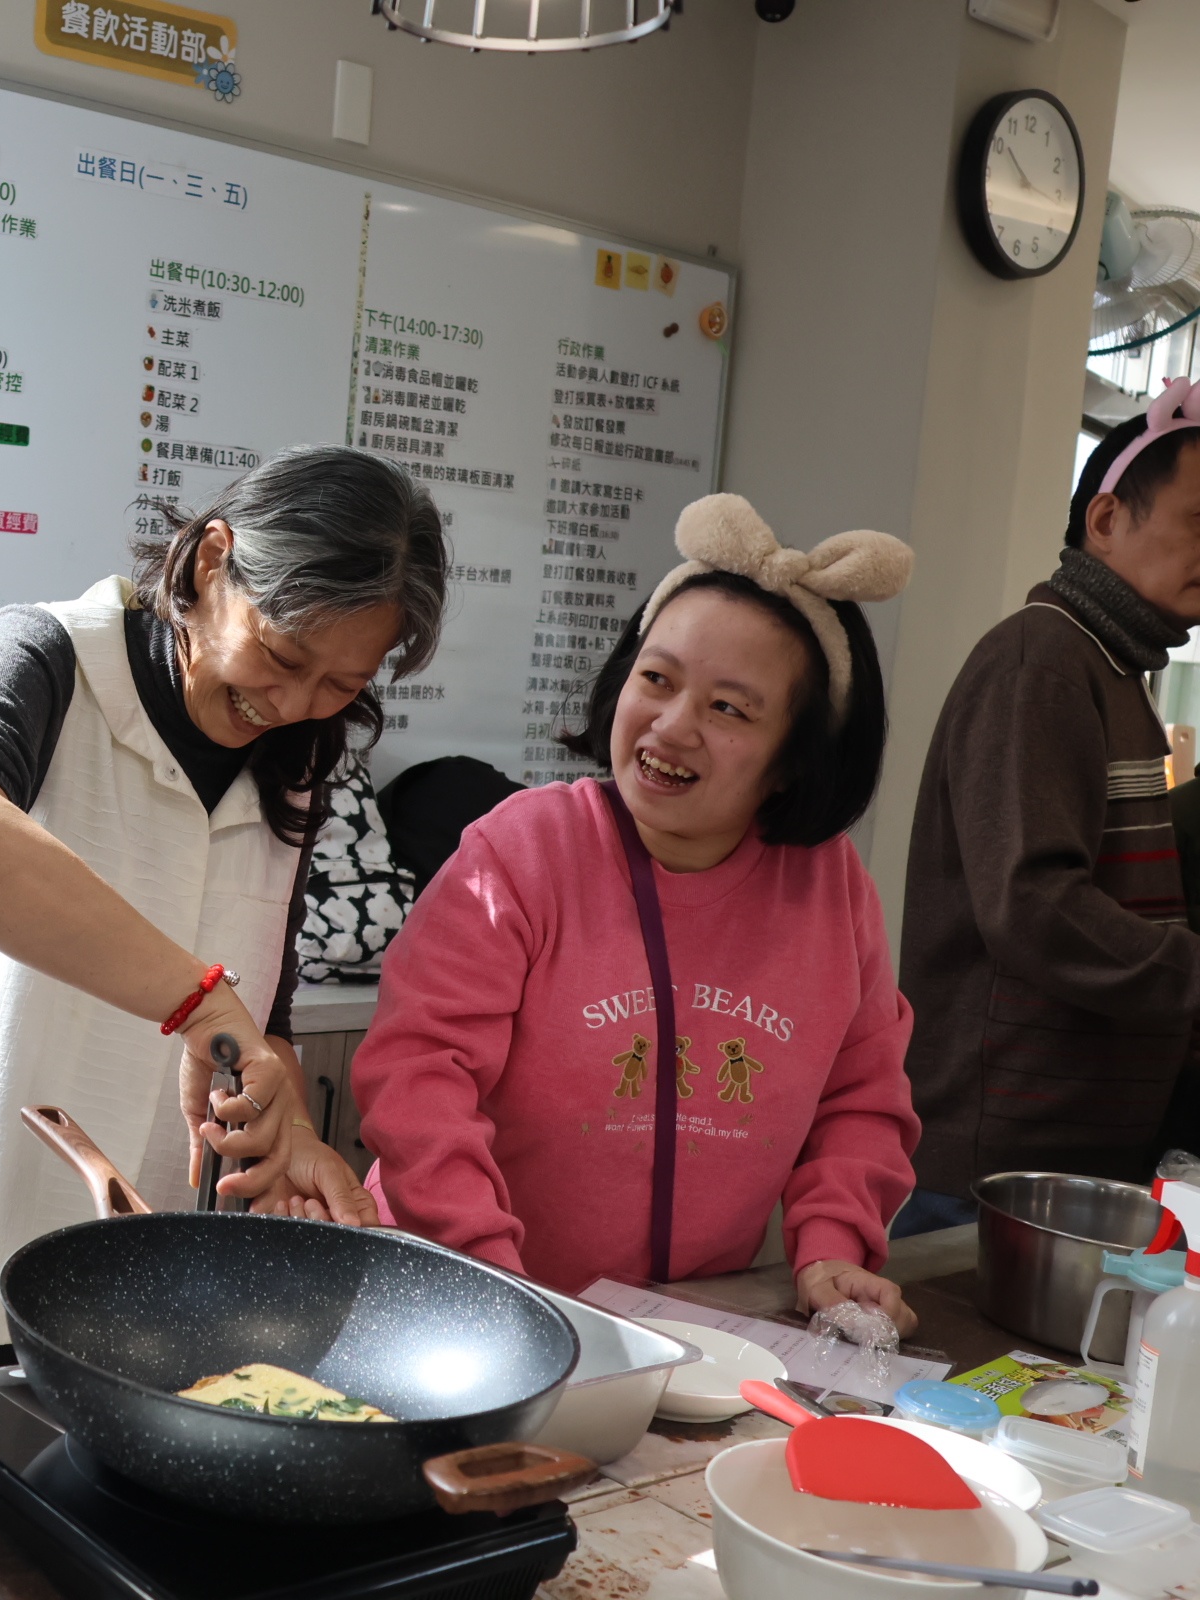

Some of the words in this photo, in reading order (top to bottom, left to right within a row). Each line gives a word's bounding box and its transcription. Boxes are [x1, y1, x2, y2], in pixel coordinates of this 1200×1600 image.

[61, 1, 207, 64] 餐飲活動部
[1008, 118, 1018, 136] 11
[1025, 114, 1037, 133] 12
[992, 135, 1004, 155] 10
[1045, 131, 1050, 147] 1
[1053, 157, 1061, 174] 2
[77, 153, 248, 209] 出餐日(一、三、五)
[997, 225, 1004, 240] 7
[1013, 239, 1021, 256] 6
[1031, 236, 1039, 253] 5
[150, 259, 305, 308] 出餐中(10:30-12:00)
[163, 294, 221, 318] 洗米煮飯
[161, 329, 190, 348] 主菜
[364, 309, 484, 349] 下午(14:00-17:30)
[365, 335, 420, 361] 清潔作業
[558, 338, 605, 361] 行政作業
[158, 359, 187, 379] 配菜
[191, 366, 198, 381] 1
[643, 376, 659, 389] ICF
[157, 390, 186, 411] 配菜
[189, 398, 199, 413] 2
[155, 415, 169, 432] 湯
[157, 441, 259, 468] 餐具準備(11:40)
[371, 434, 445, 458] 廚房器具清潔
[153, 468, 181, 488] 打飯
[692, 984, 794, 1042] BEARS
[689, 1116, 706, 1125] and
[689, 1124, 704, 1134] for
[718, 1129, 731, 1140] my
[732, 1128, 748, 1139] life
